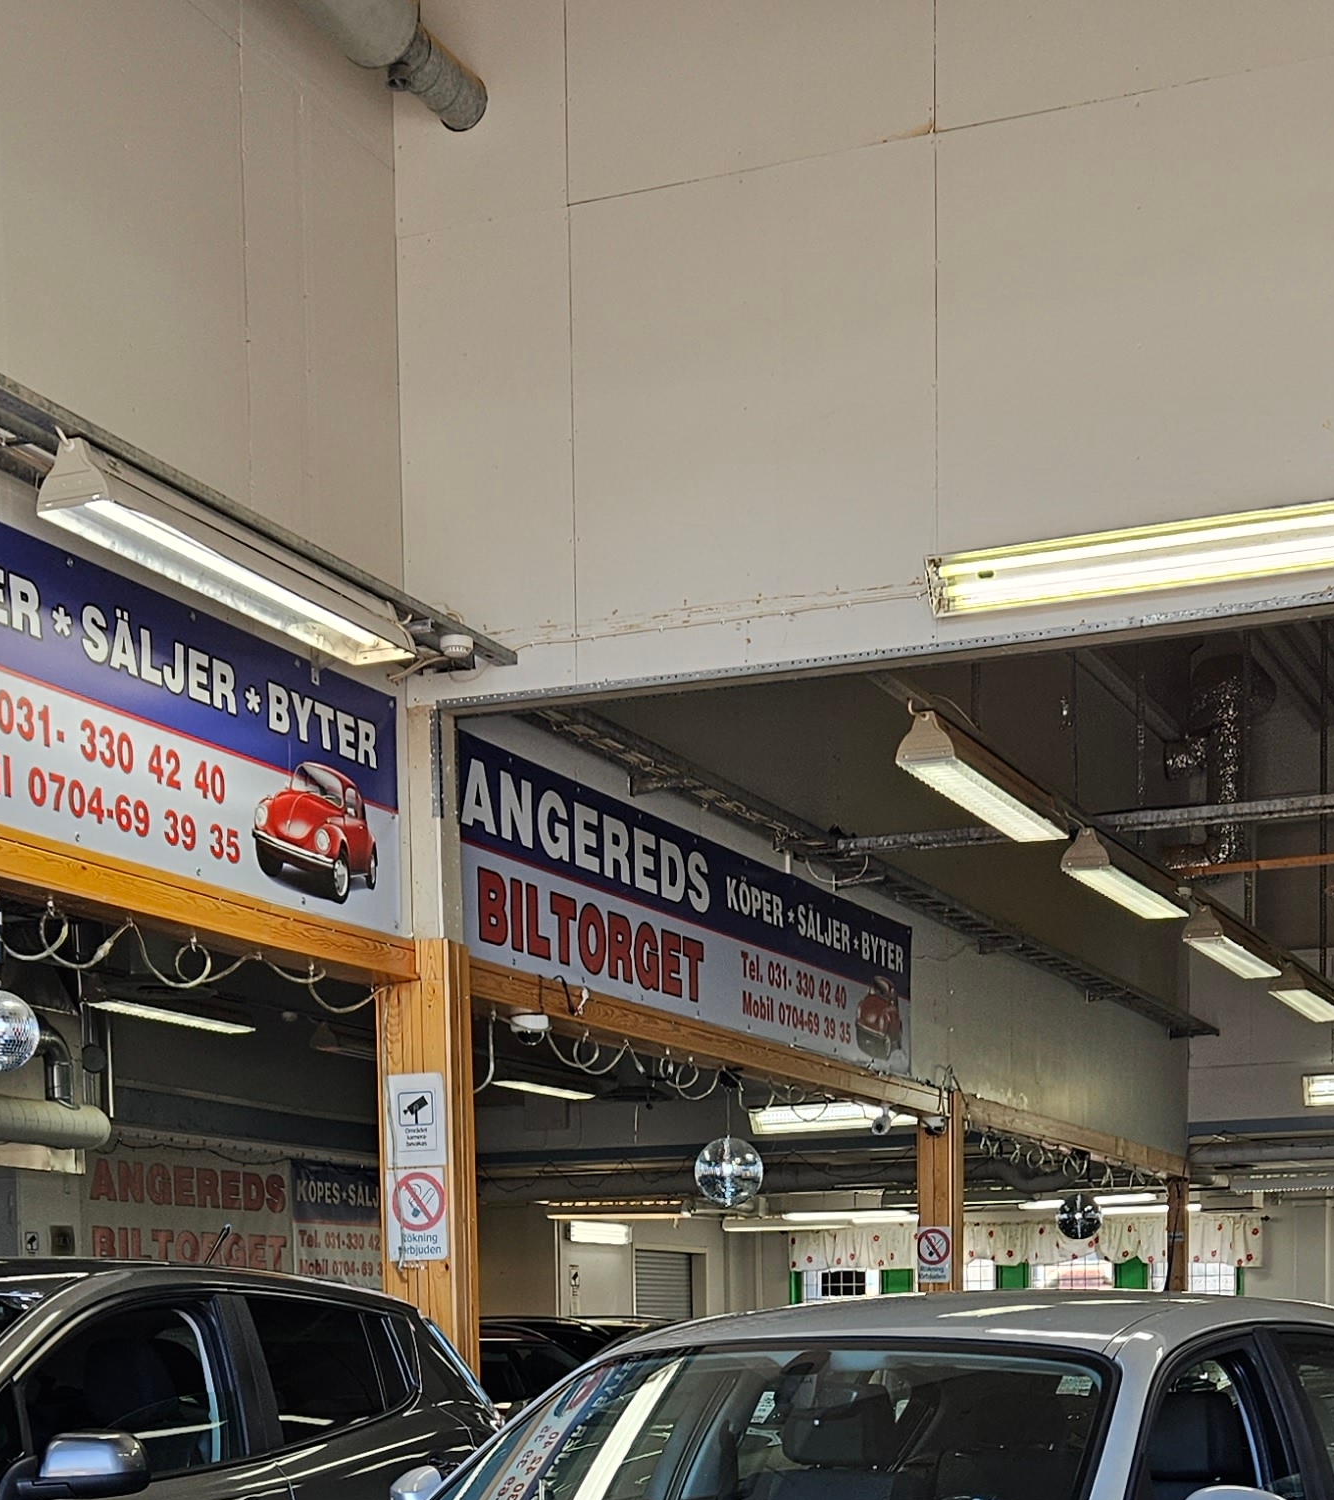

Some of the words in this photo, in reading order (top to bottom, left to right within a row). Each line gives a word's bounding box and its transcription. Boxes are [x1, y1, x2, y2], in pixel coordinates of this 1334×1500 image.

[80, 604, 238, 716] SÄLJER
[266, 681, 378, 769] BYTER
[79, 719, 134, 774] 330
[148, 744, 182, 791] 42
[194, 760, 226, 805] 40
[28, 767, 150, 838] 0704-69
[165, 810, 197, 852] 39
[209, 823, 241, 864] 35
[461, 758, 711, 914] ANGEREDS
[477, 866, 705, 1003] BILTORGET
[726, 876, 784, 929] KÖPER
[797, 903, 851, 954] SÄLJER
[861, 931, 904, 974] BYTER
[741, 950, 763, 984] Tel.
[768, 961, 792, 991] 031-
[796, 970, 815, 1000] 330
[819, 978, 831, 1006] 42
[835, 984, 847, 1010] 40
[742, 990, 774, 1023] Mobil
[779, 1002, 820, 1036] 0704-69
[824, 1016, 836, 1041] 39
[840, 1021, 852, 1045] 35
[89, 1158, 287, 1214] ANGEREDS
[299, 1230, 321, 1249] Tel.
[324, 1231, 364, 1251] 031-330
[299, 1259, 328, 1276] Mobil
[332, 1260, 373, 1277] 0704-69
